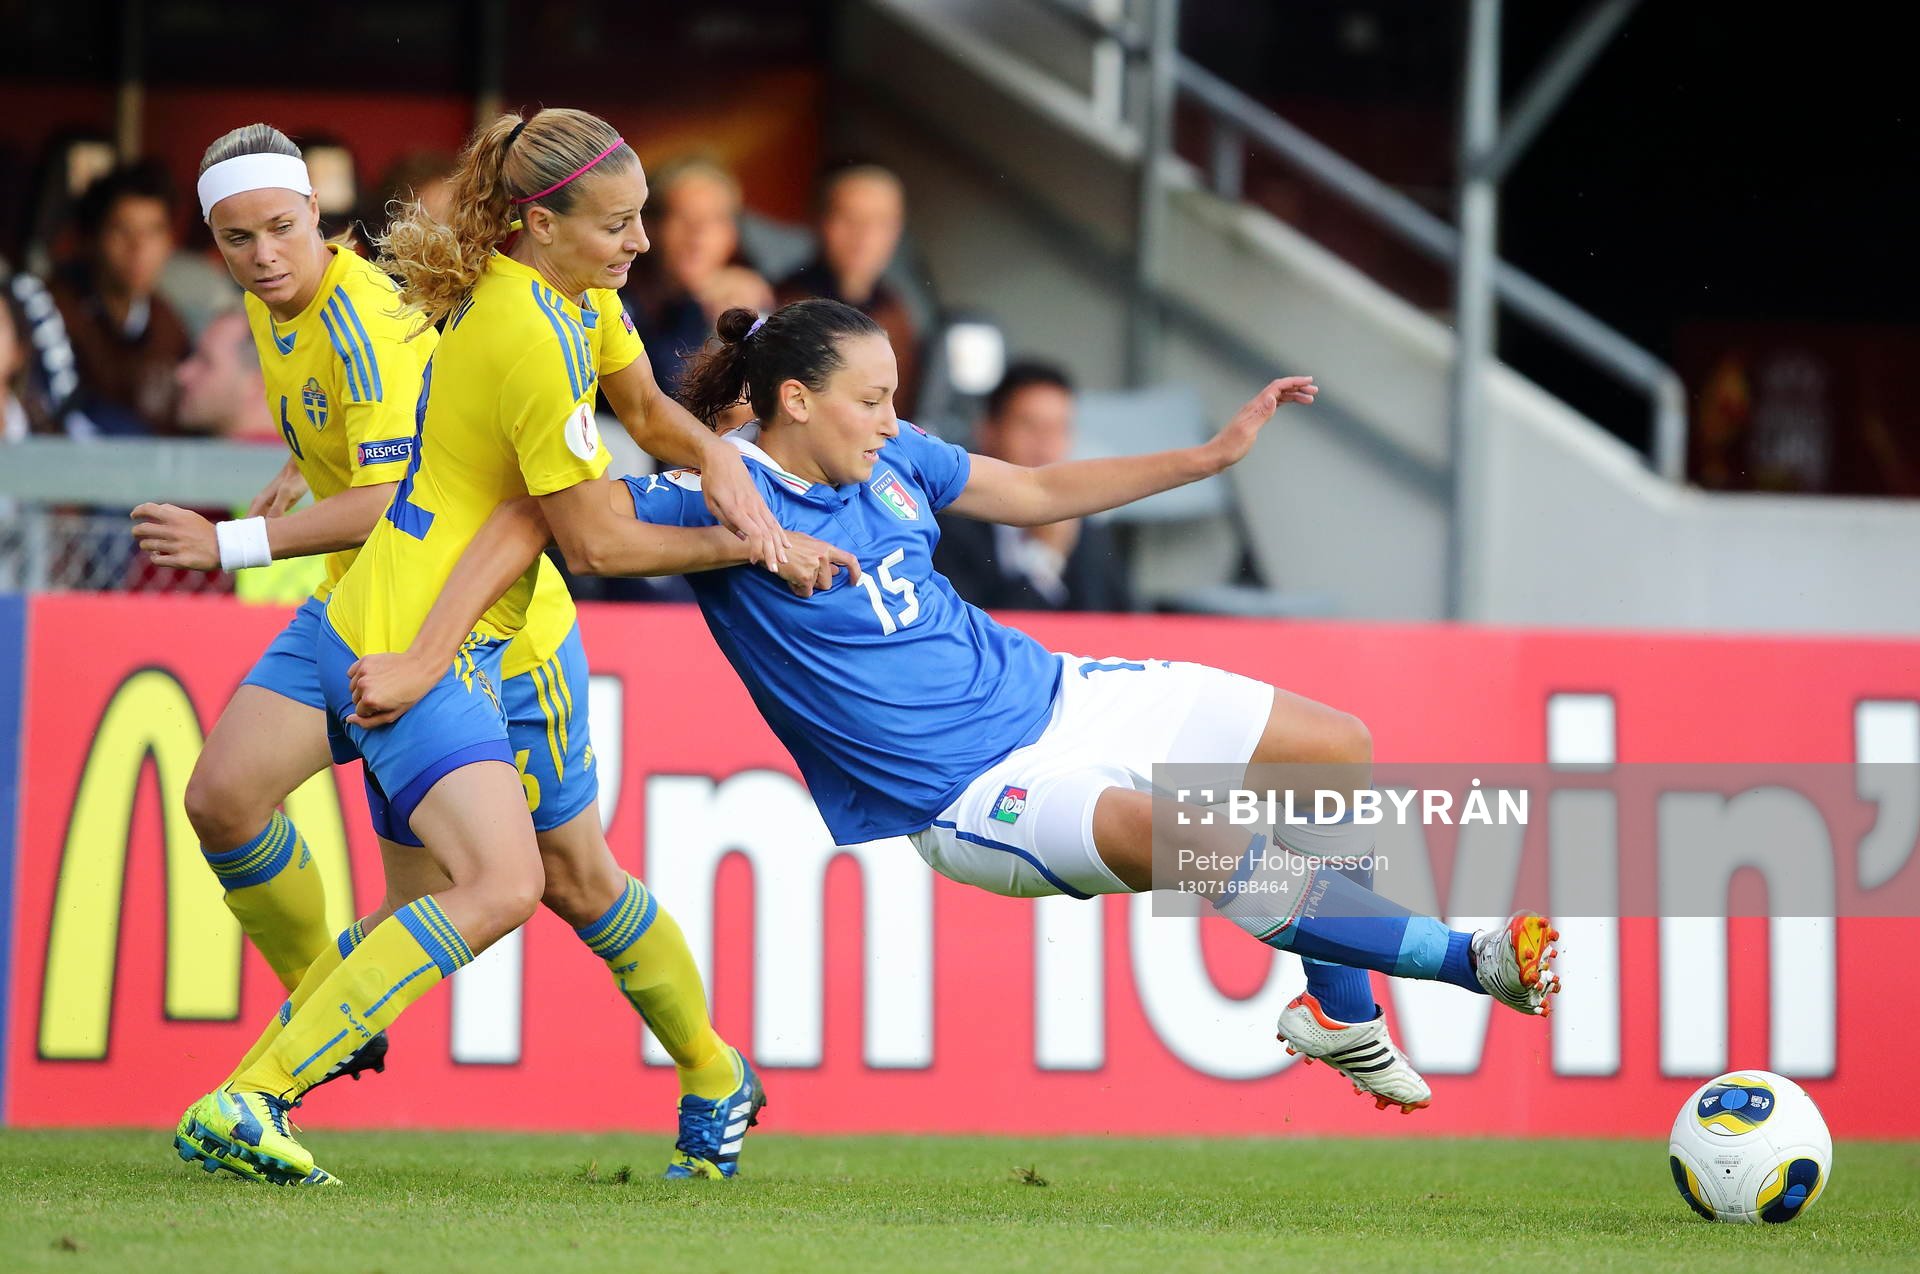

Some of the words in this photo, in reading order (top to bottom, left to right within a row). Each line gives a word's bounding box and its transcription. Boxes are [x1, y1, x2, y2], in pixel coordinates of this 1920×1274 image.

[280, 395, 305, 461] 6
[365, 443, 412, 459] RESPECT
[875, 477, 892, 494] ITALIA
[855, 547, 919, 637] 15
[1303, 879, 1331, 920] ITALIA
